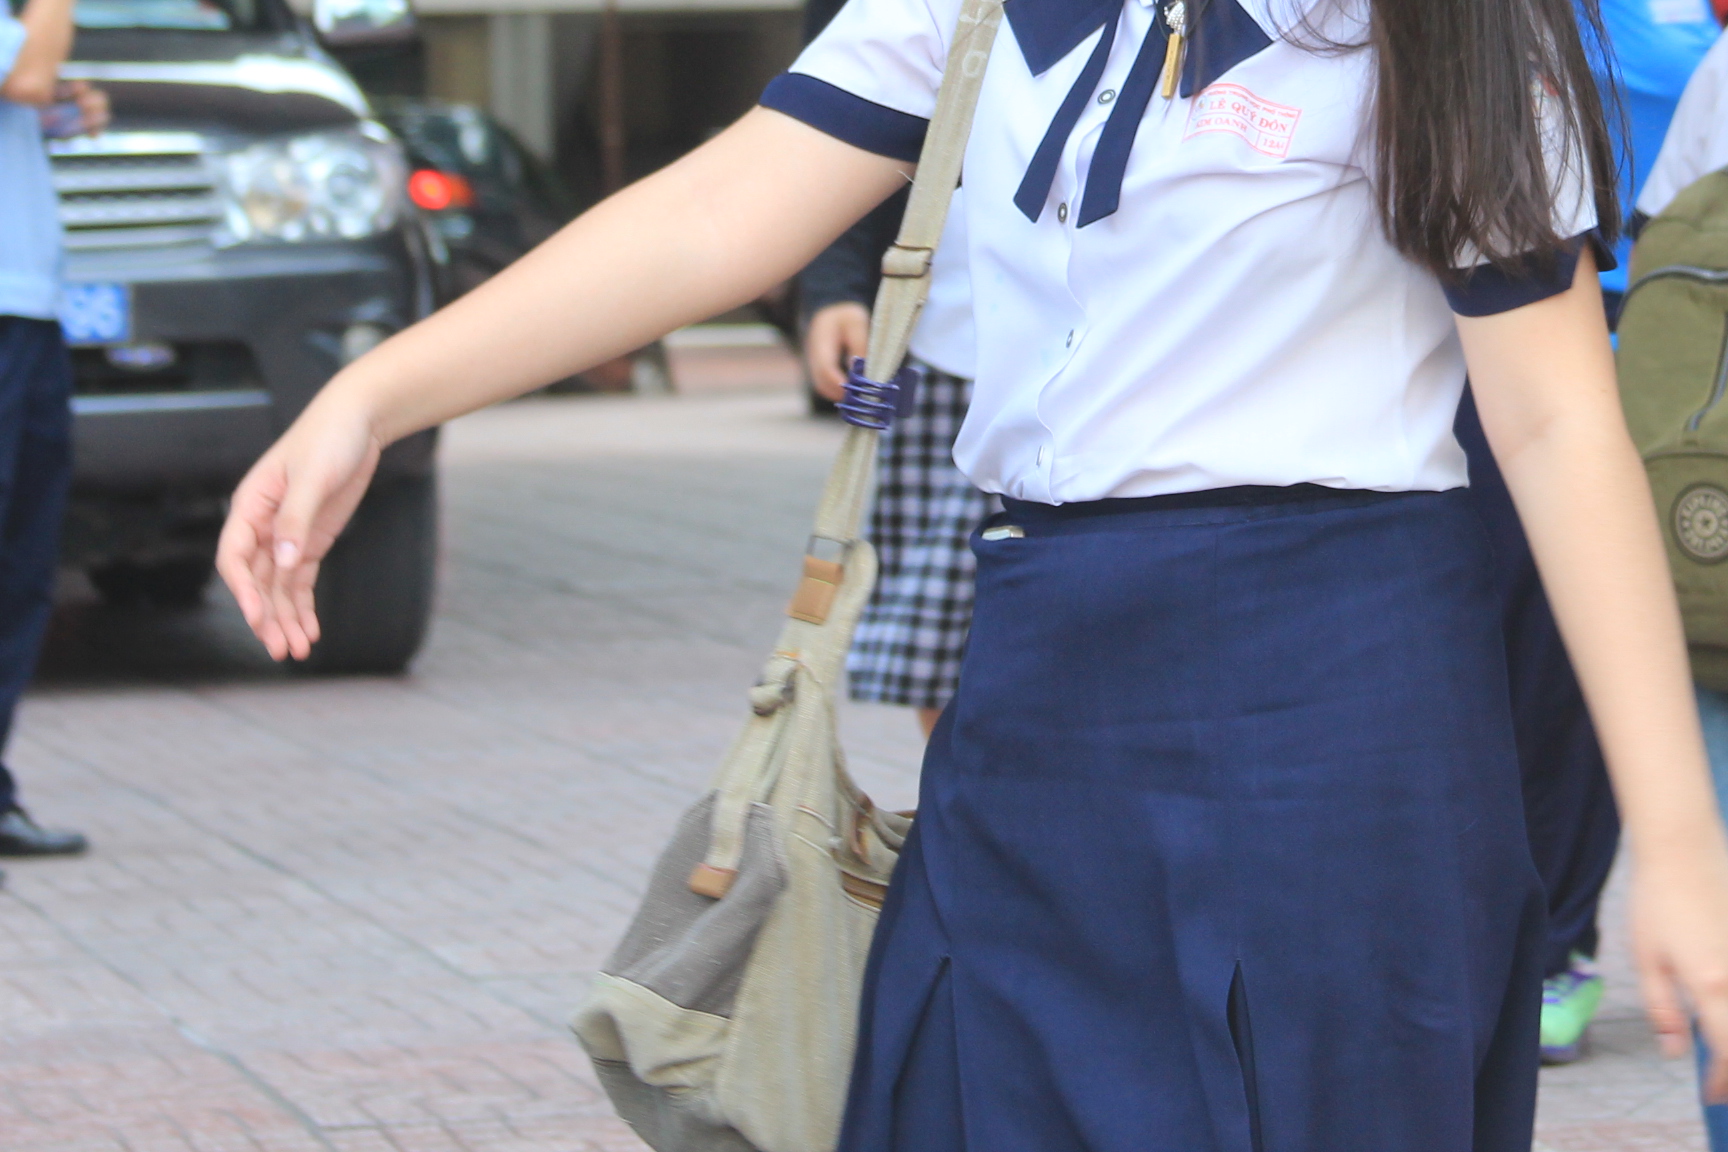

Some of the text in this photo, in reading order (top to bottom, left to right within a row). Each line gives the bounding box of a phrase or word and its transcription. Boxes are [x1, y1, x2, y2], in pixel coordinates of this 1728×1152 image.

[1209, 98, 1226, 110] LÊ
[1259, 117, 1288, 133] ĐÔN
[1214, 117, 1248, 132] OANH
